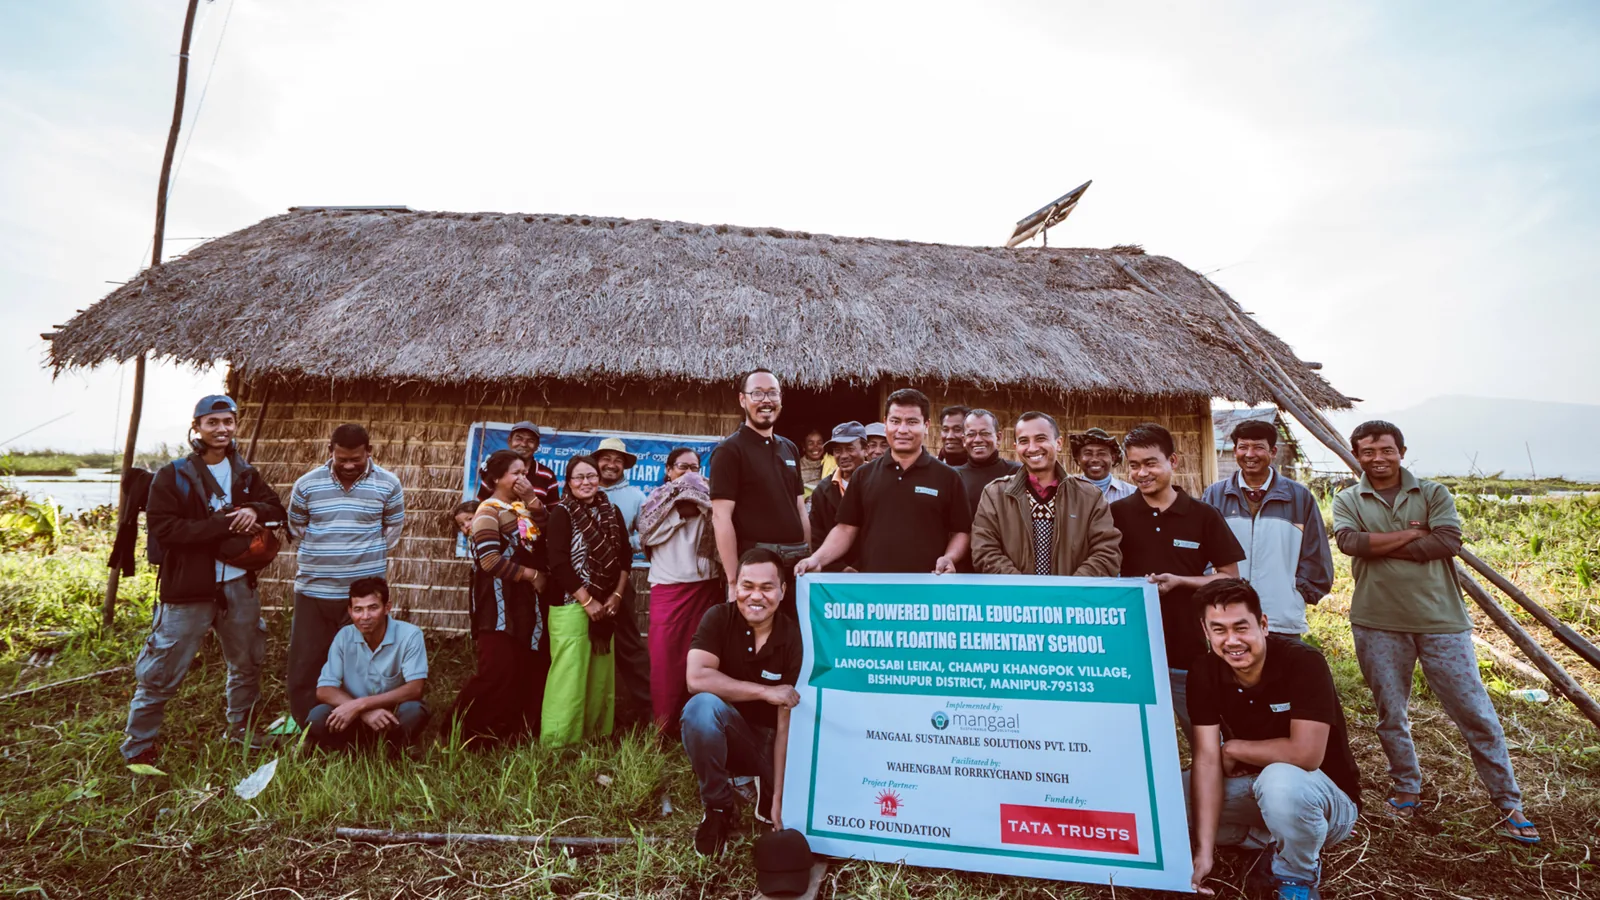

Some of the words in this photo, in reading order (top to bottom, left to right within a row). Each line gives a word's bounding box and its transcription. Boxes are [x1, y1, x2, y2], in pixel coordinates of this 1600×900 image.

[824, 602, 864, 620] SOLAR
[867, 603, 930, 621] POWERED
[932, 604, 984, 622] DIGITAL
[986, 605, 1063, 624] EDUCATION
[1066, 607, 1127, 625] PROJECT
[846, 630, 894, 648] LOKTAK
[896, 631, 957, 650] FLOATING
[960, 632, 1045, 652] ELEMENTARY
[1048, 635, 1106, 654] SCHOOL
[834, 658, 904, 671] LANGOLSABI
[907, 660, 946, 674] LEIKAI,
[948, 662, 999, 674] CHAMPU
[1002, 663, 1075, 677] KHANGPOK
[1077, 666, 1132, 680] VILLAGE,
[867, 673, 933, 687] BISHNUPUR
[936, 676, 987, 690] DISTRICT,
[990, 679, 1095, 693] MANIPUR-795133
[945, 701, 991, 711] Implemented
[992, 703, 1003, 713] by:
[952, 713, 1020, 732] mangaal
[866, 729, 913, 743] MANGAAL
[915, 733, 981, 747] SUSTAINABLE
[983, 737, 1041, 750] SOLUTIONS
[1044, 740, 1066, 752] PVT.
[1068, 742, 1092, 753] LTD.
[886, 761, 952, 776] WAHENGBAM
[954, 766, 1033, 782] RORRKYCHAND
[1035, 771, 1070, 784] SINGH
[951, 756, 989, 767] Facilitated
[990, 759, 1001, 769] by:
[862, 777, 887, 788] Project
[888, 780, 919, 790] Partner:
[1044, 794, 1074, 804] Funded
[1075, 796, 1087, 807] by:
[827, 814, 866, 829] SELCO
[869, 819, 952, 838] FOUNDATION
[1008, 819, 1053, 835] TATA
[1057, 823, 1130, 842] TRUSTS
